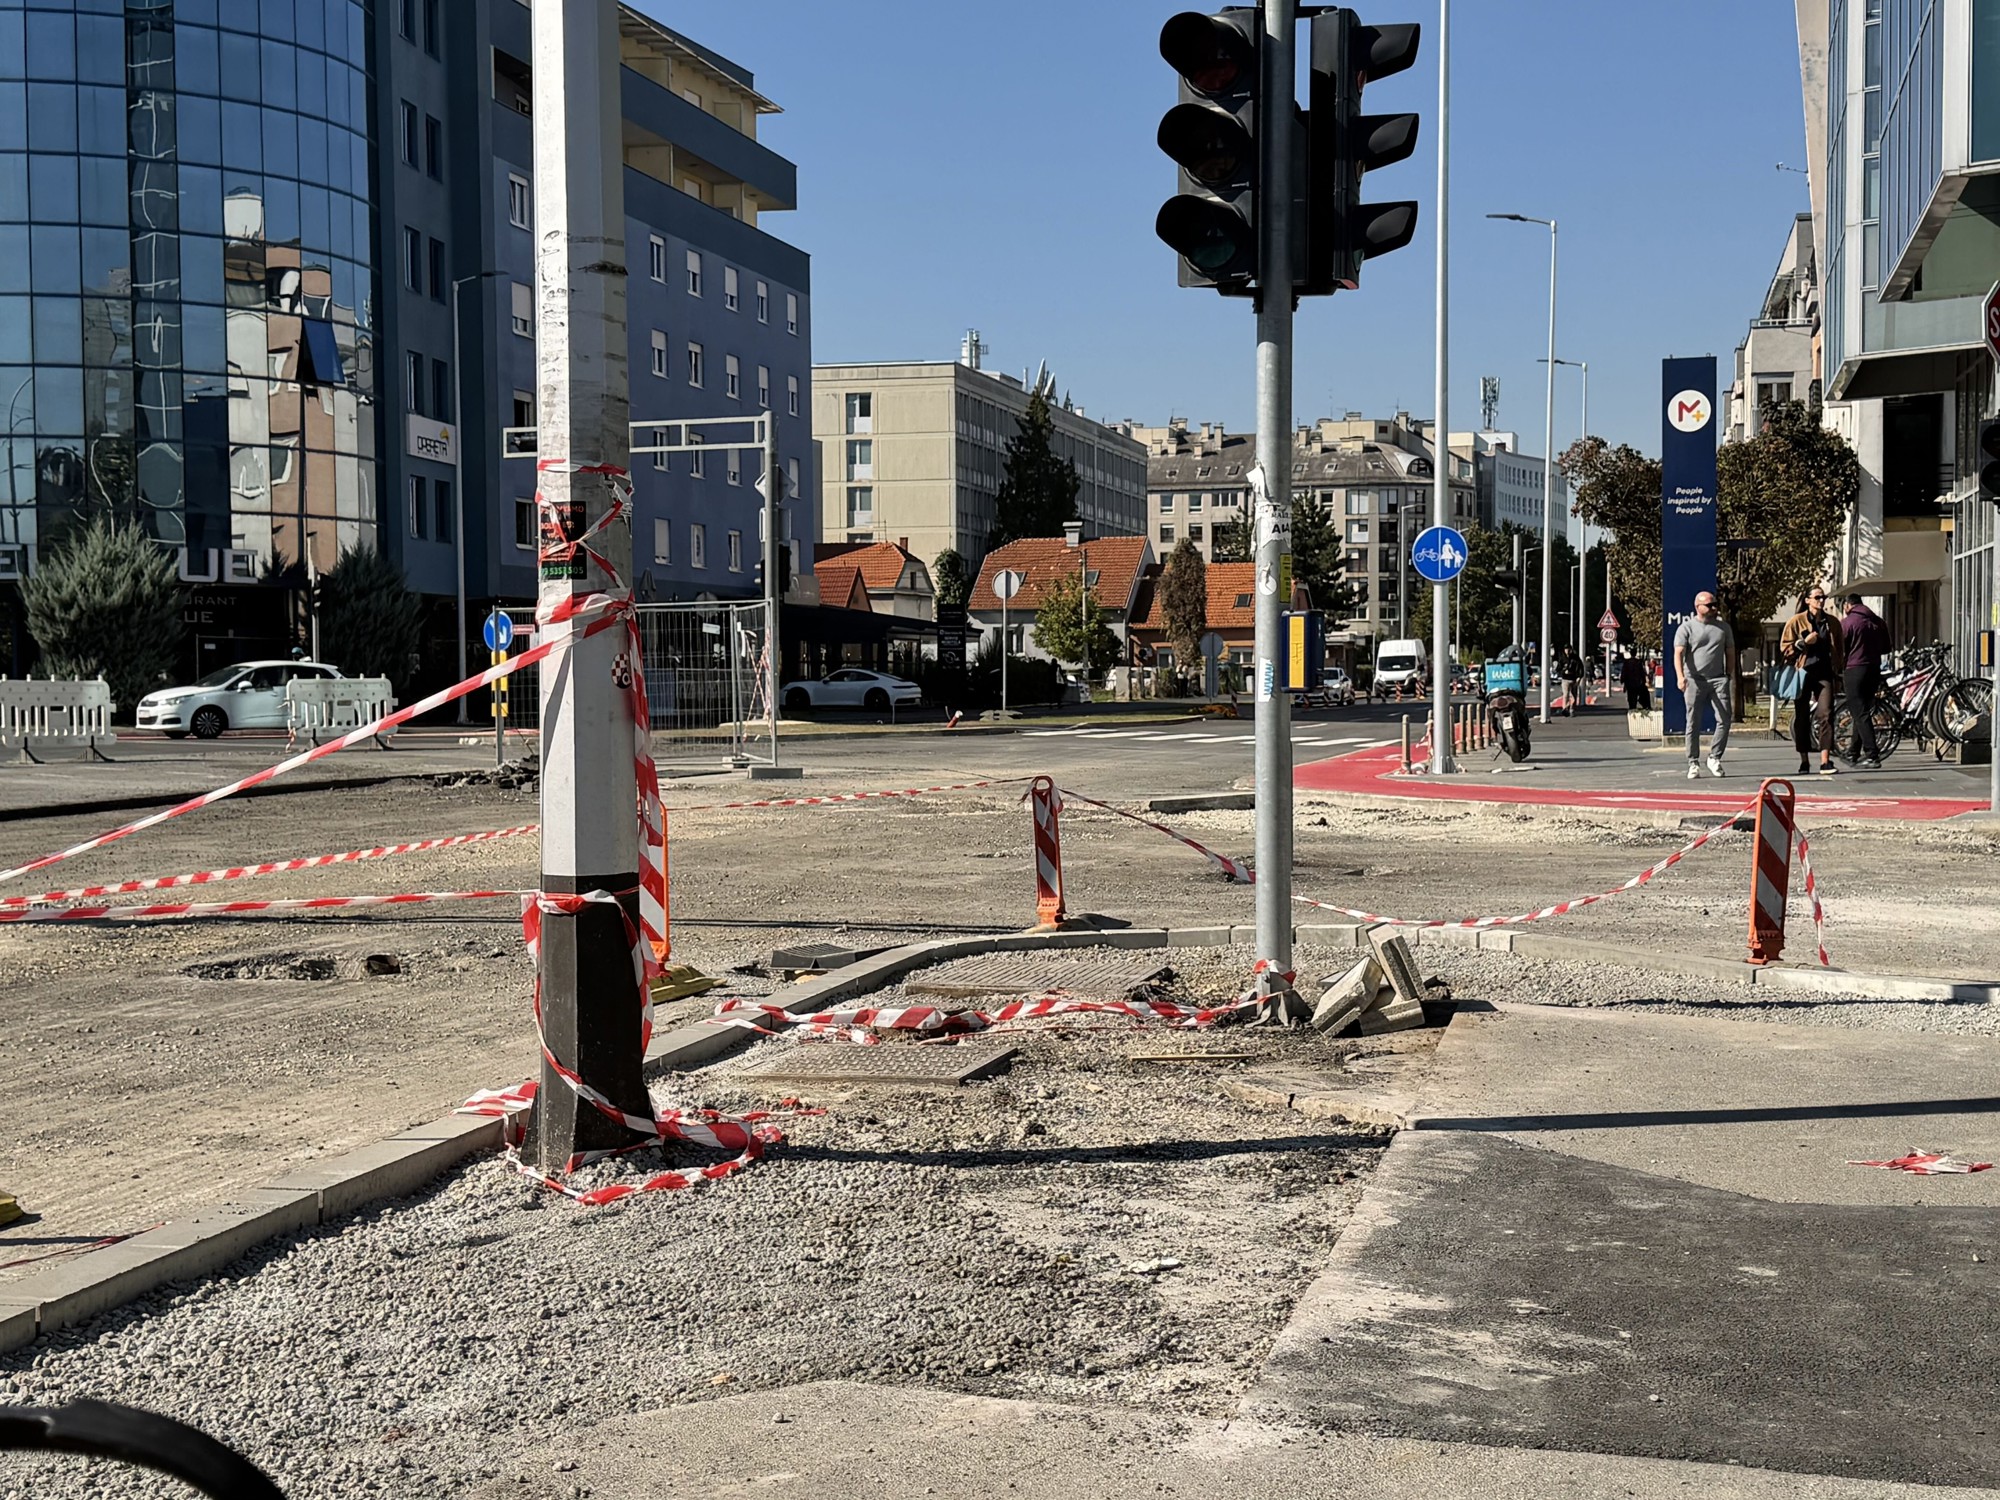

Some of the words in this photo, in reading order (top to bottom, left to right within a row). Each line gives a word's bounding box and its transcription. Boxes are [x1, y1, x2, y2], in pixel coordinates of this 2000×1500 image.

[1675, 486, 1703, 496] People
[1667, 497, 1700, 506] inspired
[1701, 496, 1713, 506] by
[1675, 506, 1703, 515] People
[177, 547, 259, 585] UE
[1603, 630, 1614, 640] 40
[1491, 670, 1515, 679] Wolt
